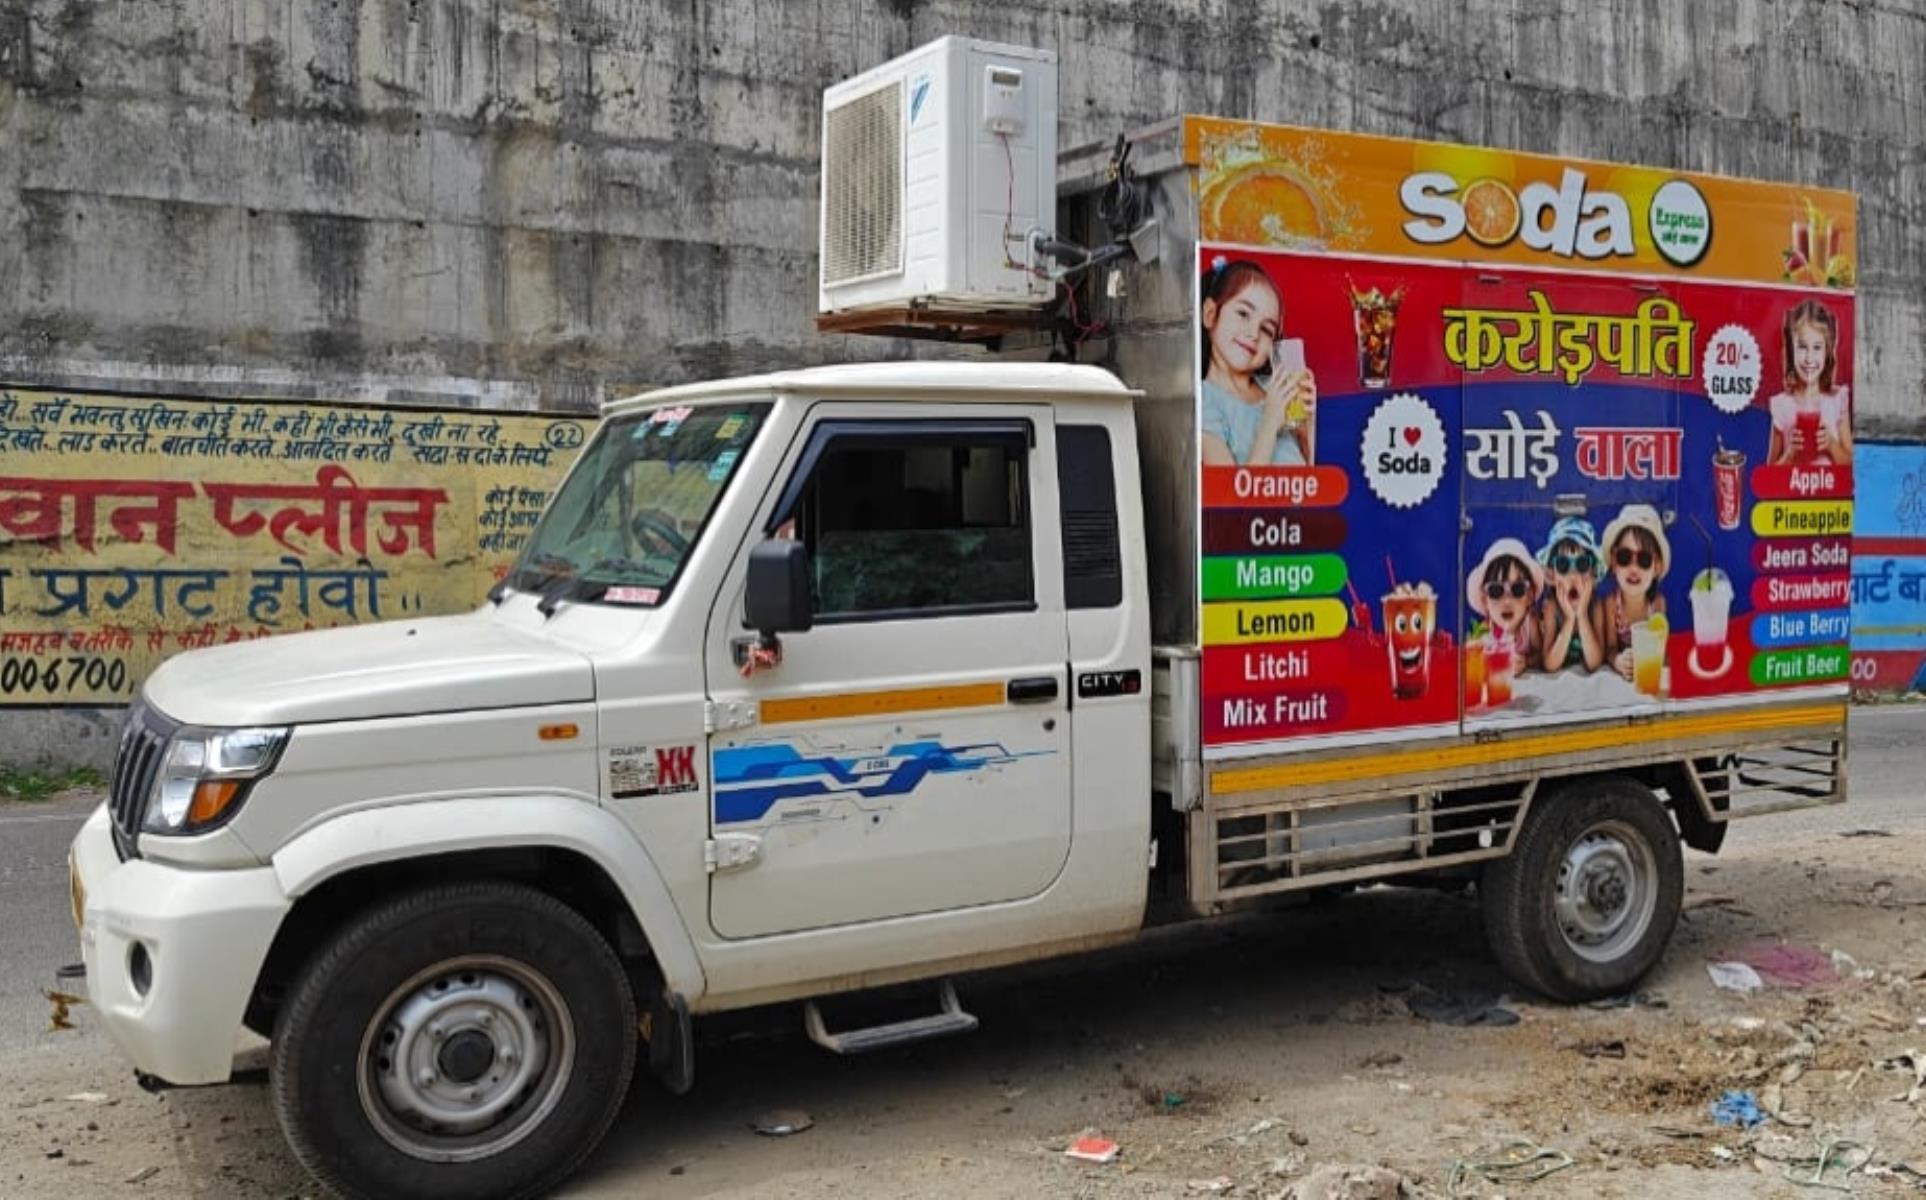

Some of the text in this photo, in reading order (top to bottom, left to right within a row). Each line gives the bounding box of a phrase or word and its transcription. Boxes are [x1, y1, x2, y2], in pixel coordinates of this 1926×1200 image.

[1400, 166, 1636, 260] soda
[1442, 290, 1695, 387] करोड़पति
[1712, 375, 1753, 394] GLASS
[1389, 427, 1396, 448] I
[1378, 451, 1431, 474] Soda
[1573, 427, 1683, 481] वाला
[1234, 469, 1319, 504] Orange
[1789, 467, 1835, 495] Apple
[201, 464, 450, 560] प्लीज
[1773, 507, 1850, 533] Pineapple
[1250, 518, 1301, 546] Cola
[1762, 542, 1848, 569] Jeera Soda
[1237, 559, 1314, 593] Mango
[248, 556, 389, 626] होवो
[1768, 578, 1854, 604] Strawberry
[1238, 609, 1315, 636] Lemon
[1770, 612, 1849, 639] Blue Berry
[1244, 650, 1308, 681] Litchi
[1766, 653, 1841, 680] Fruit Beer
[1082, 674, 1123, 687] CITY
[1224, 694, 1328, 727] Mix Fruit
